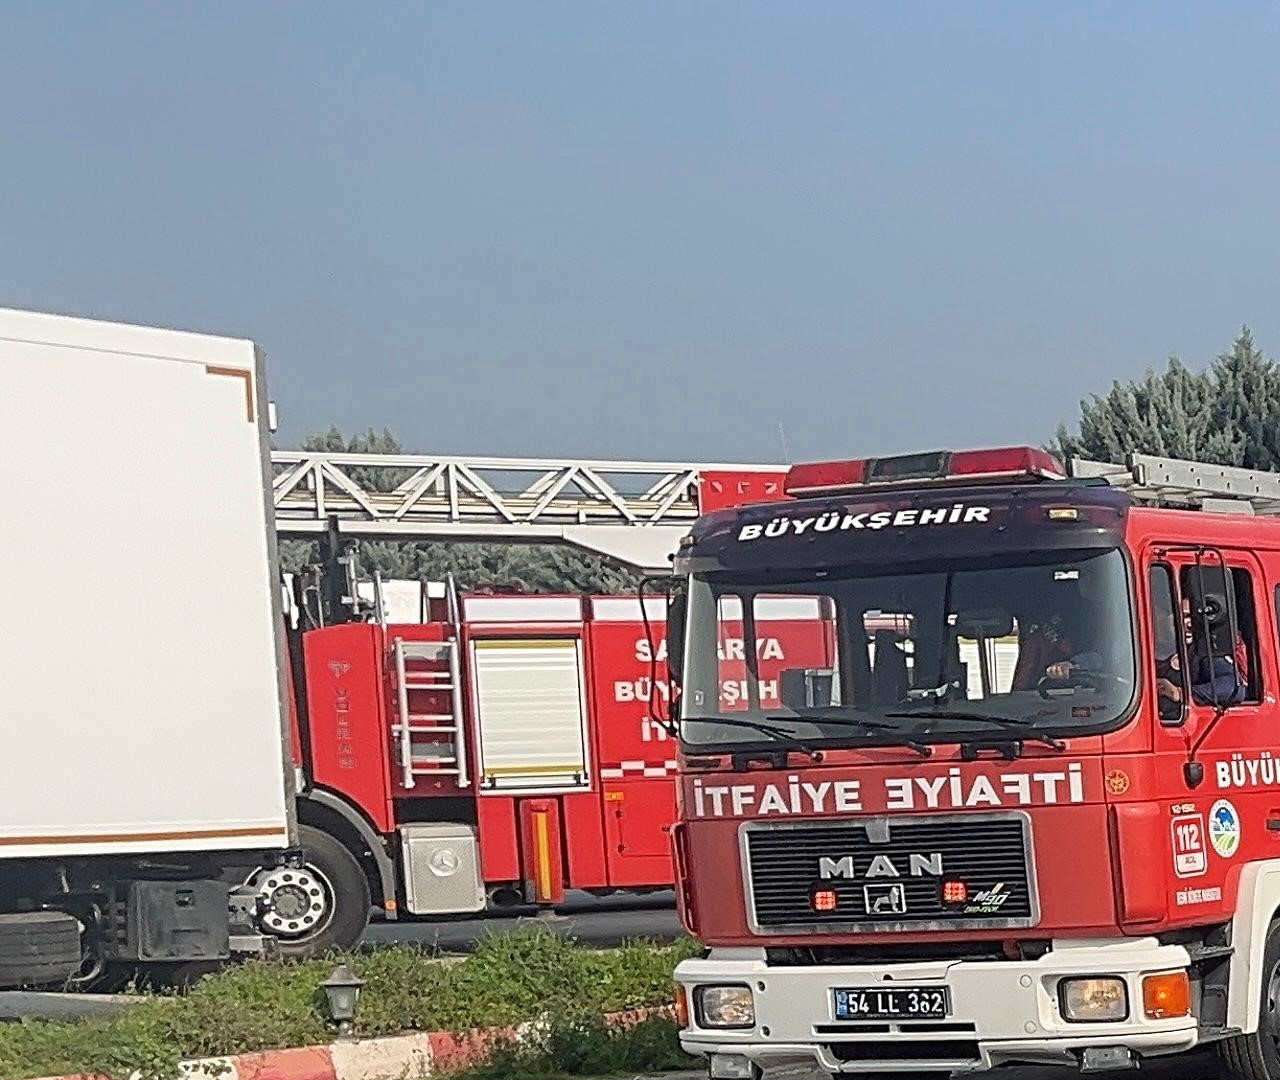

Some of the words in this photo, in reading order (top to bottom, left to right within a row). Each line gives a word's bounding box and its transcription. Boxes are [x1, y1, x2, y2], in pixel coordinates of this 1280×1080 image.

[738, 503, 991, 541] BÜYÜKŞEHİR
[694, 775, 862, 817] İTFAİYE
[1177, 823, 1201, 852] 112
[818, 853, 944, 879] MAN
[848, 993, 870, 1013] 54
[877, 993, 900, 1013] LL
[907, 992, 943, 1013] 362
